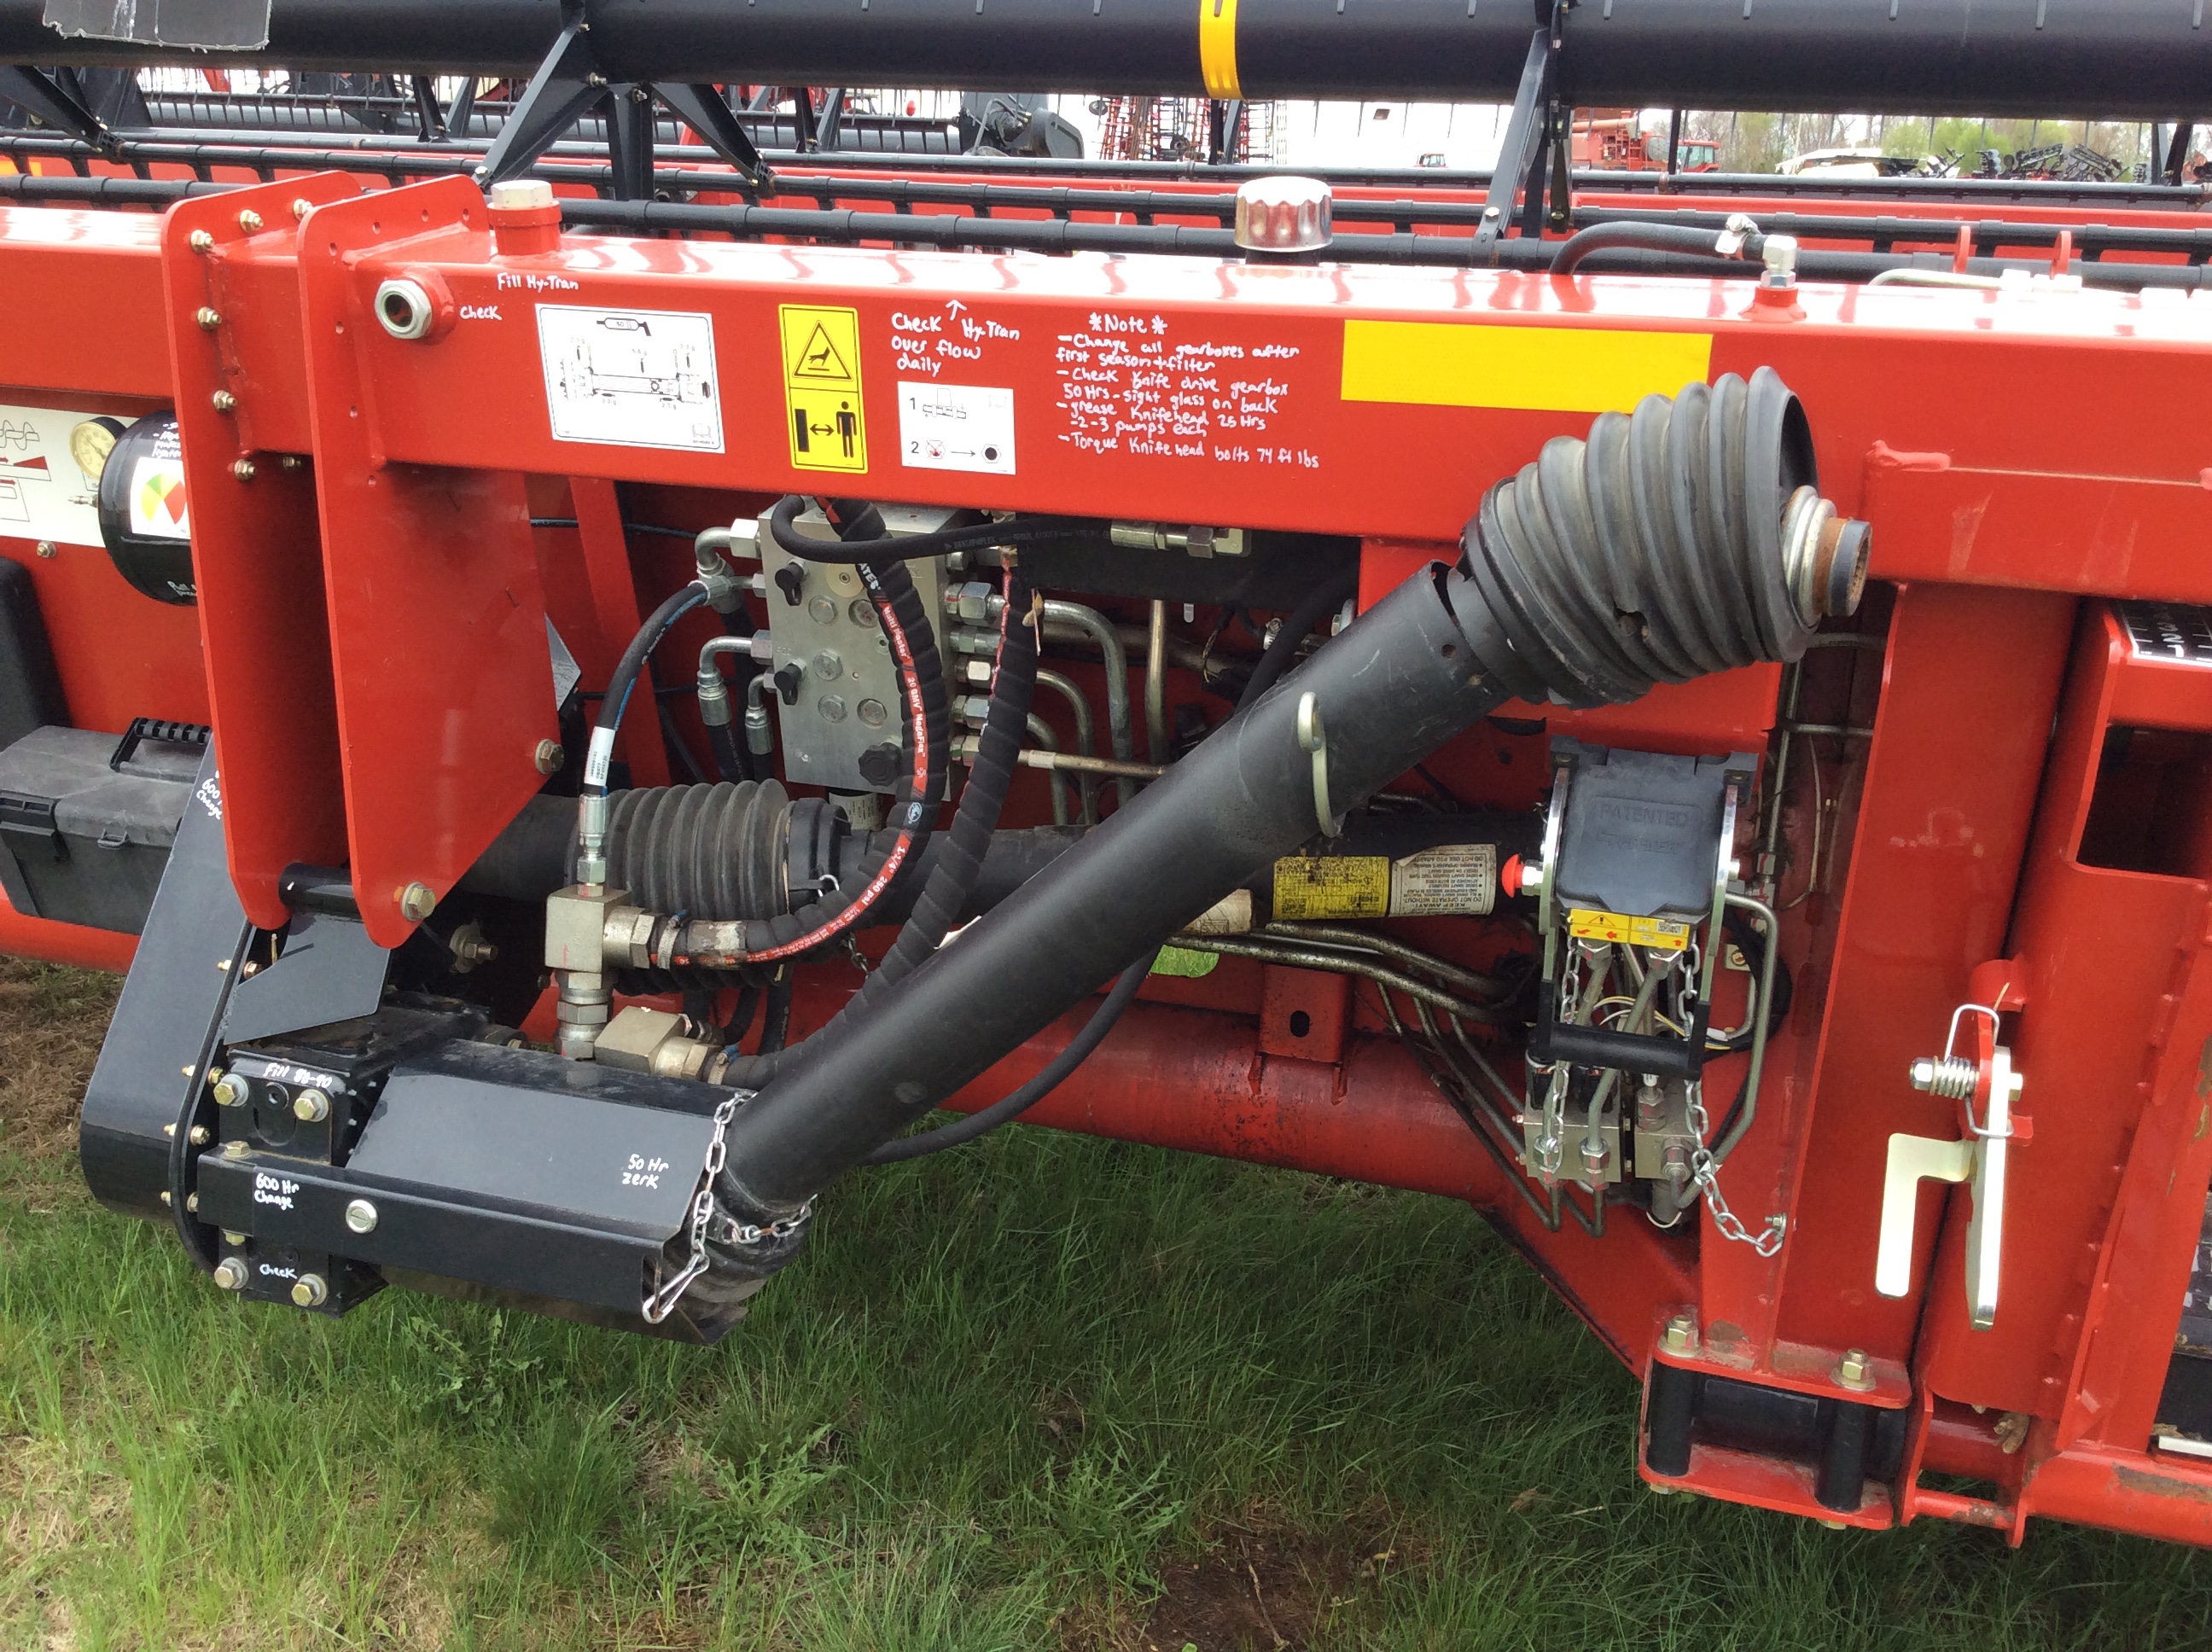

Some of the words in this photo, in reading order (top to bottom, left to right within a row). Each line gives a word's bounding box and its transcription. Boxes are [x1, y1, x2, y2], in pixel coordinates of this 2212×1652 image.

[497, 272, 521, 291] Fill
[527, 275, 579, 293] Hy-Tran
[891, 312, 942, 333] Check
[961, 317, 1020, 342] Hy-Tran
[891, 334, 928, 354] Over
[935, 340, 981, 360] flow
[1056, 346, 1090, 363] first
[1098, 352, 1151, 367] season
[1141, 340, 1162, 353] all
[1175, 341, 1244, 359] gearboxes
[1252, 345, 1300, 358] after
[896, 352, 941, 378] daily
[1181, 375, 1220, 393] drive
[1231, 378, 1288, 399] gearbox
[909, 397, 916, 410] 1
[1063, 383, 1082, 398] 50
[1084, 384, 1109, 399] Hrs
[1123, 390, 1161, 404] sight
[1170, 391, 1205, 410] glass
[1212, 398, 1232, 410] on
[1240, 397, 1278, 413] back
[1115, 421, 1166, 439] pumps
[1173, 423, 1207, 437] each
[1217, 414, 1237, 428] 25
[1240, 415, 1266, 430] Hrs
[911, 440, 919, 454] 2
[1214, 445, 1249, 462] bolts
[1256, 447, 1272, 464] 74
[1278, 448, 1292, 463] ft
[1297, 449, 1319, 468] lbs
[858, 562, 880, 590] ATES
[882, 606, 897, 628] Multi
[2161, 633, 2185, 643] 2
[2167, 644, 2185, 658] 1
[201, 777, 221, 800] 600
[872, 875, 888, 893] 250
[262, 1062, 290, 1077] Fill
[627, 1153, 644, 1170] 50
[648, 1157, 669, 1172] Hr
[256, 1172, 280, 1191] 600
[282, 1179, 300, 1195] Hr
[254, 1190, 294, 1211] Change
[259, 1263, 298, 1280] Check
